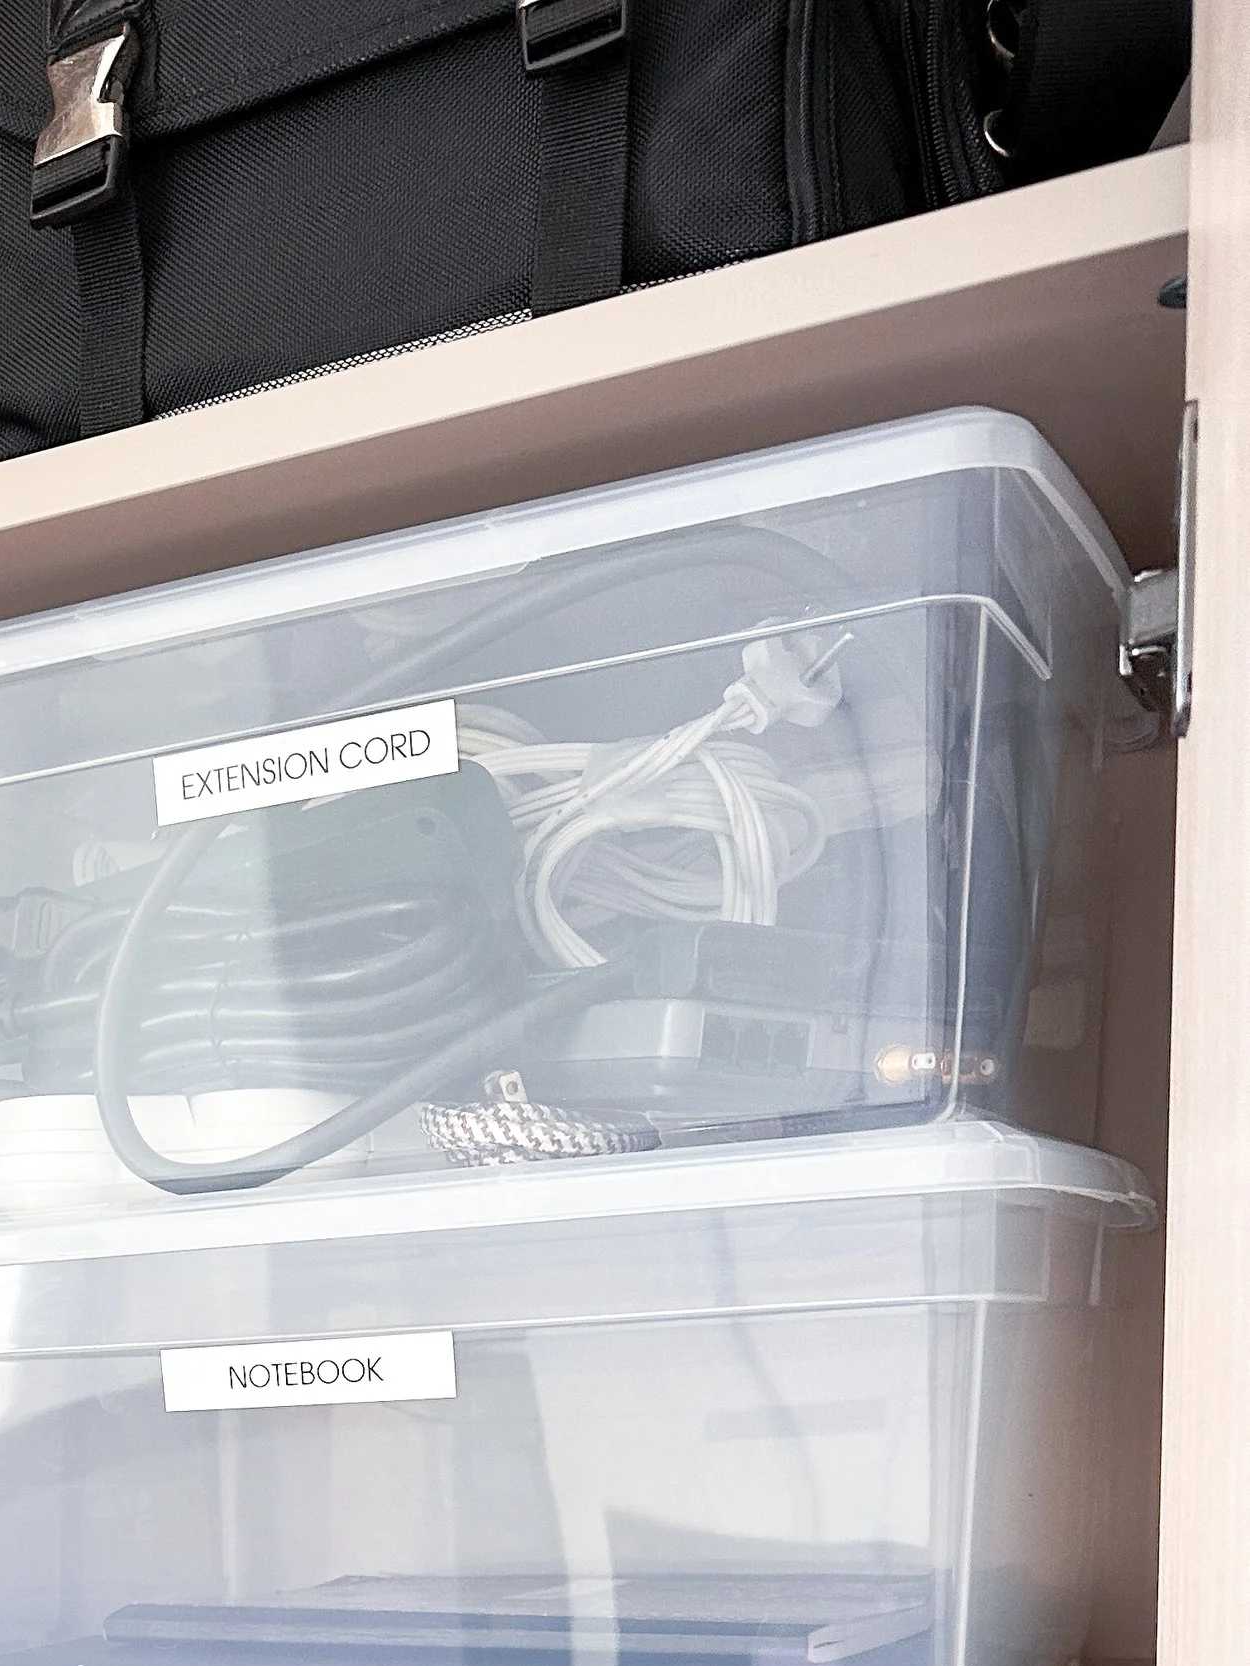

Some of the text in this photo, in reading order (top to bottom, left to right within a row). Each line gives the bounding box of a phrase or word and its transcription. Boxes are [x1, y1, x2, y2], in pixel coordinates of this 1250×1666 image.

[181, 729, 431, 800] EXTENSION CORD
[229, 1356, 384, 1390] NOTEBOOK
